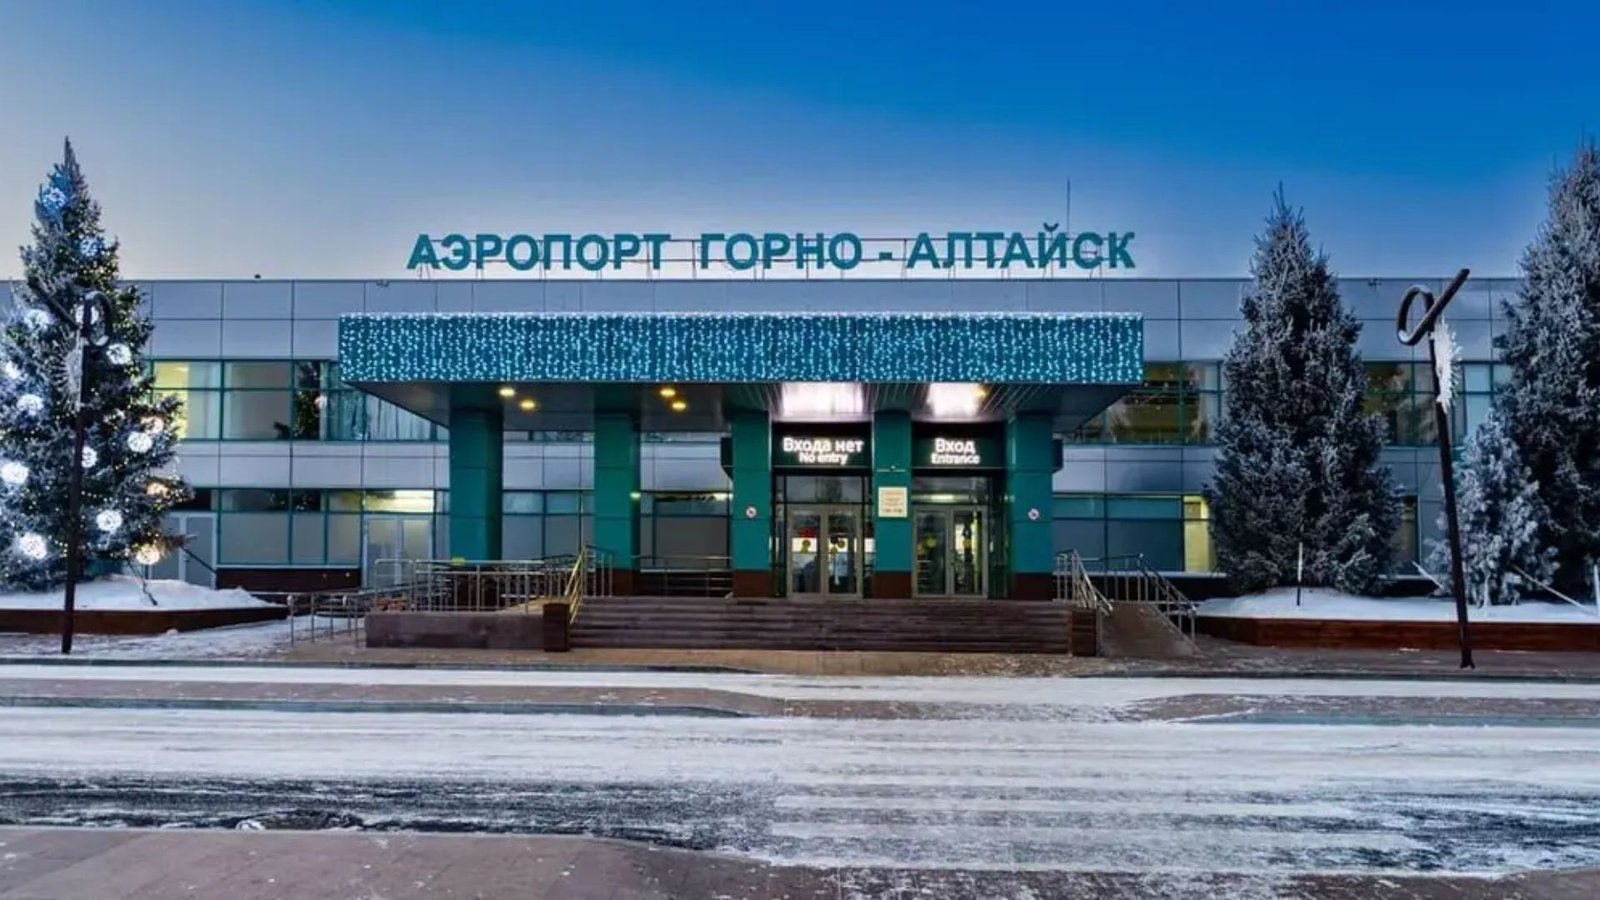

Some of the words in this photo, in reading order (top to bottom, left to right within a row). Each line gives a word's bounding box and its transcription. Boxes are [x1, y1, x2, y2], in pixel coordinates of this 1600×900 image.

[406, 233, 672, 271] АЭРОПОРТ
[700, 232, 862, 270] ГОРНО
[906, 222, 1136, 269] АЛТАЙСК
[783, 437, 832, 453] Входа
[834, 440, 864, 453] нет
[934, 437, 976, 454] Вход
[798, 452, 815, 463] No
[817, 453, 848, 465] entry
[930, 453, 981, 465] Entrance
